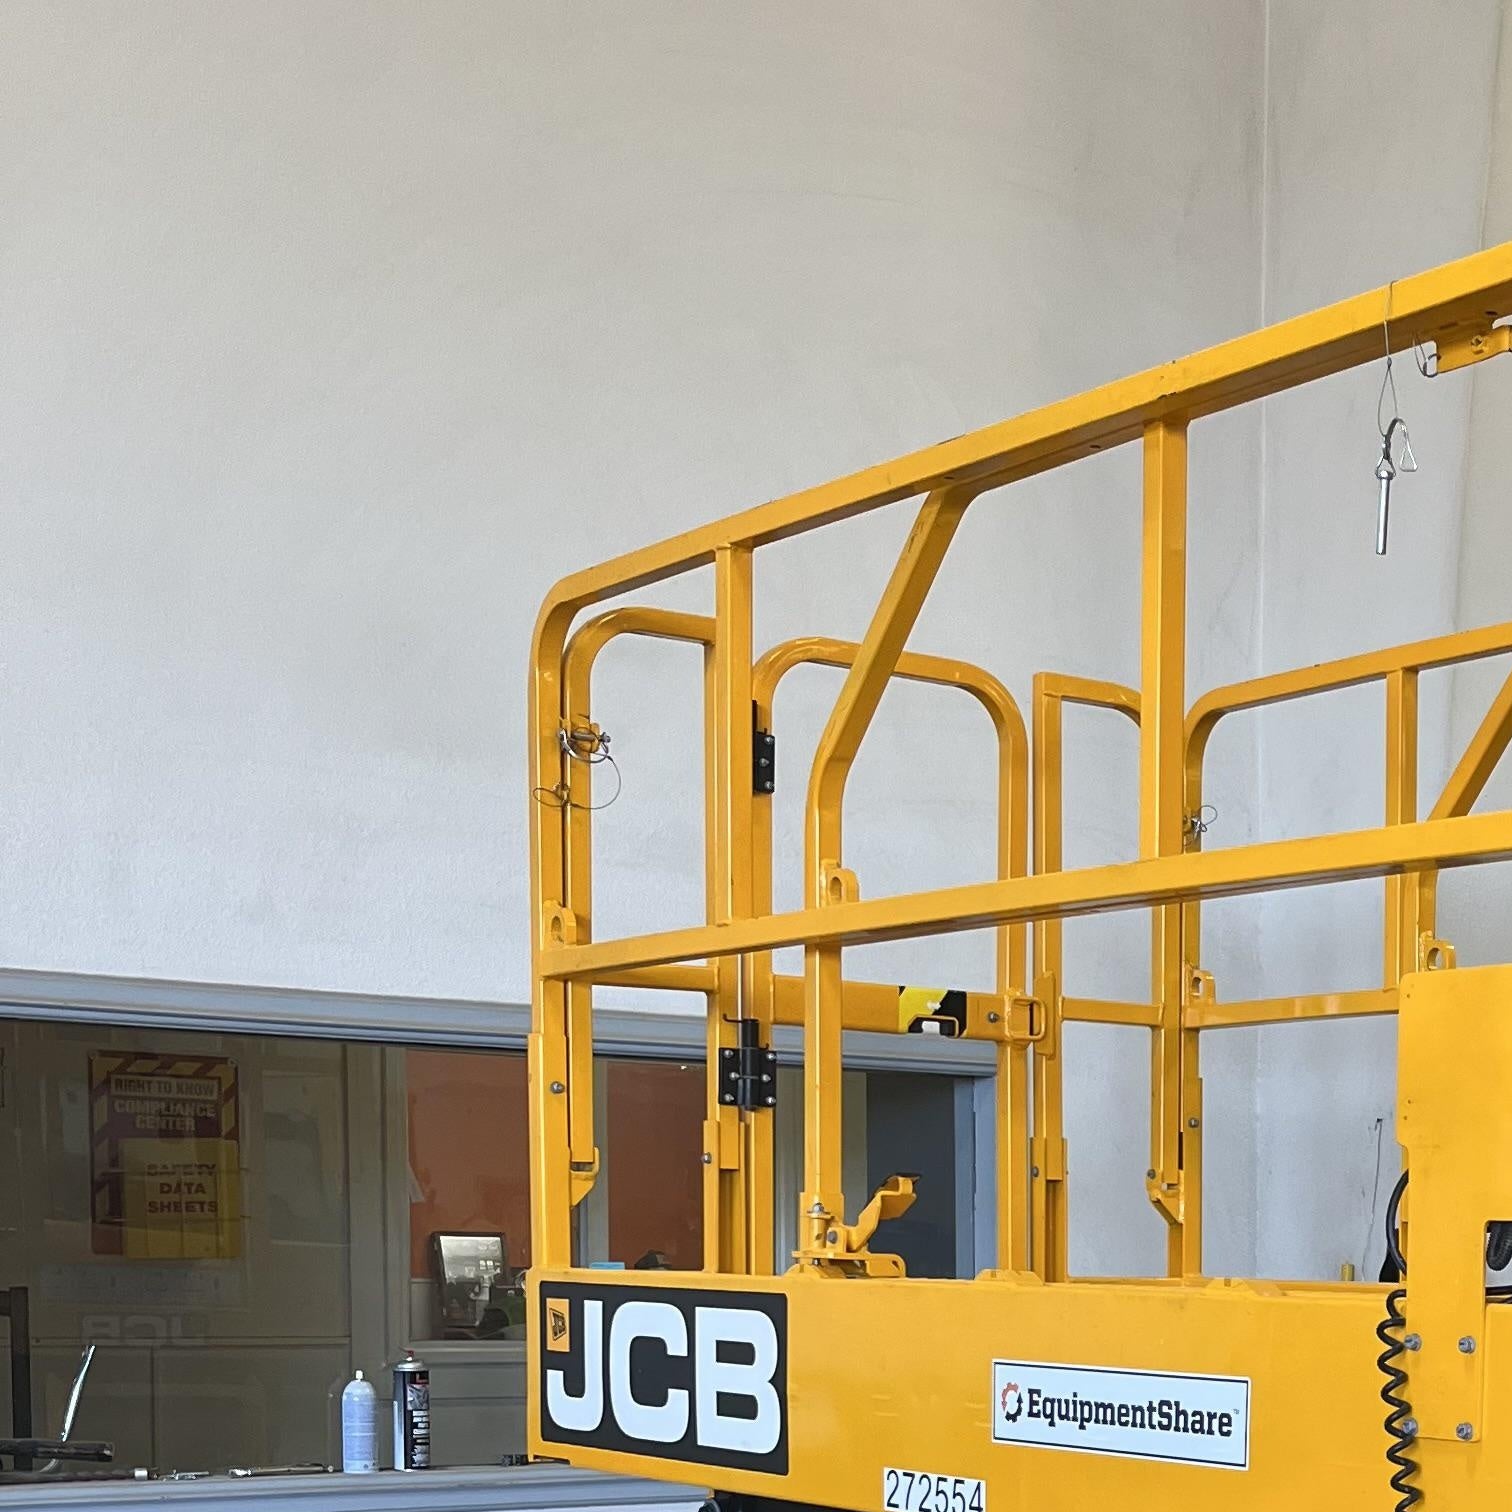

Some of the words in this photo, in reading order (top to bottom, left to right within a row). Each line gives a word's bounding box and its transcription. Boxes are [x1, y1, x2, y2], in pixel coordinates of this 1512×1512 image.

[114, 1078, 154, 1093] RIGHT
[156, 1080, 173, 1095] TO
[175, 1081, 216, 1096] KNOW
[114, 1100, 216, 1117] COMPLIANCE
[136, 1114, 196, 1131] CENTER
[159, 1182, 207, 1195] DATA
[148, 1200, 219, 1214] SHEETS
[546, 1299, 781, 1455] JCB
[1027, 1388, 1234, 1438] EquipmentShare
